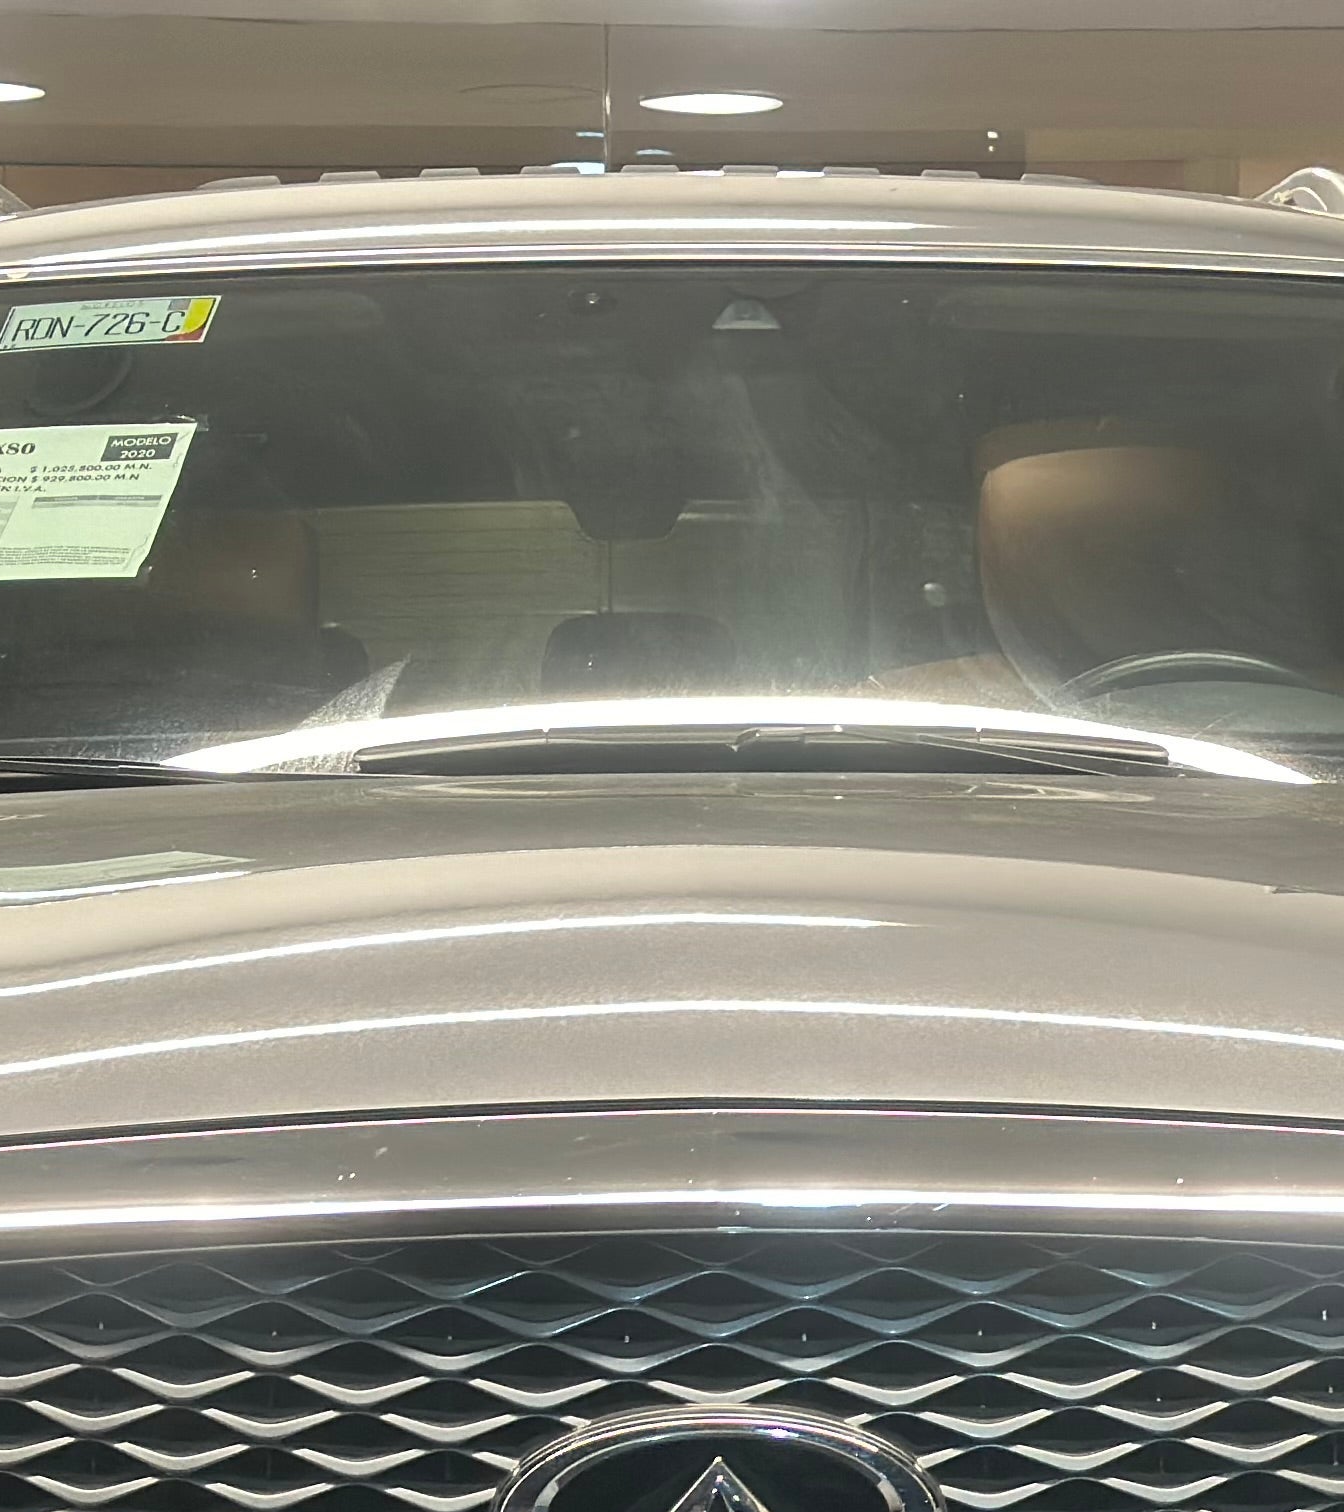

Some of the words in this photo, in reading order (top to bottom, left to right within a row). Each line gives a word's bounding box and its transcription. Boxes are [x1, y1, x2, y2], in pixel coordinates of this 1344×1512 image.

[12, 311, 185, 341] RDN-726-C
[111, 436, 172, 447] MODELO
[119, 449, 156, 459] 2020
